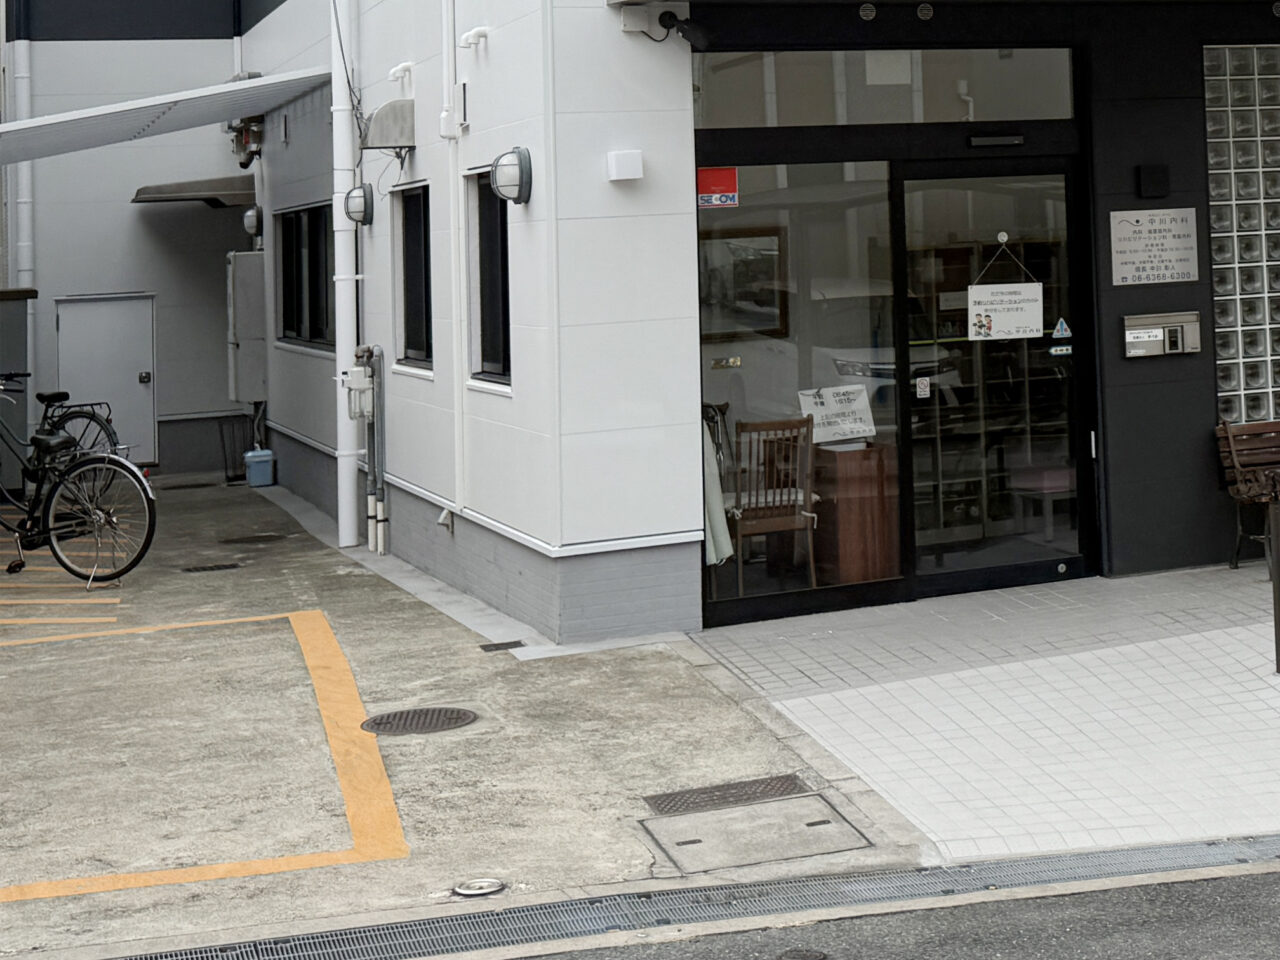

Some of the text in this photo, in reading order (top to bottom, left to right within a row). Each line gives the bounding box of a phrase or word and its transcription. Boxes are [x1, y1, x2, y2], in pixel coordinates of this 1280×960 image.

[700, 194, 736, 205] SECOM
[1148, 216, 1188, 225] 中川内科
